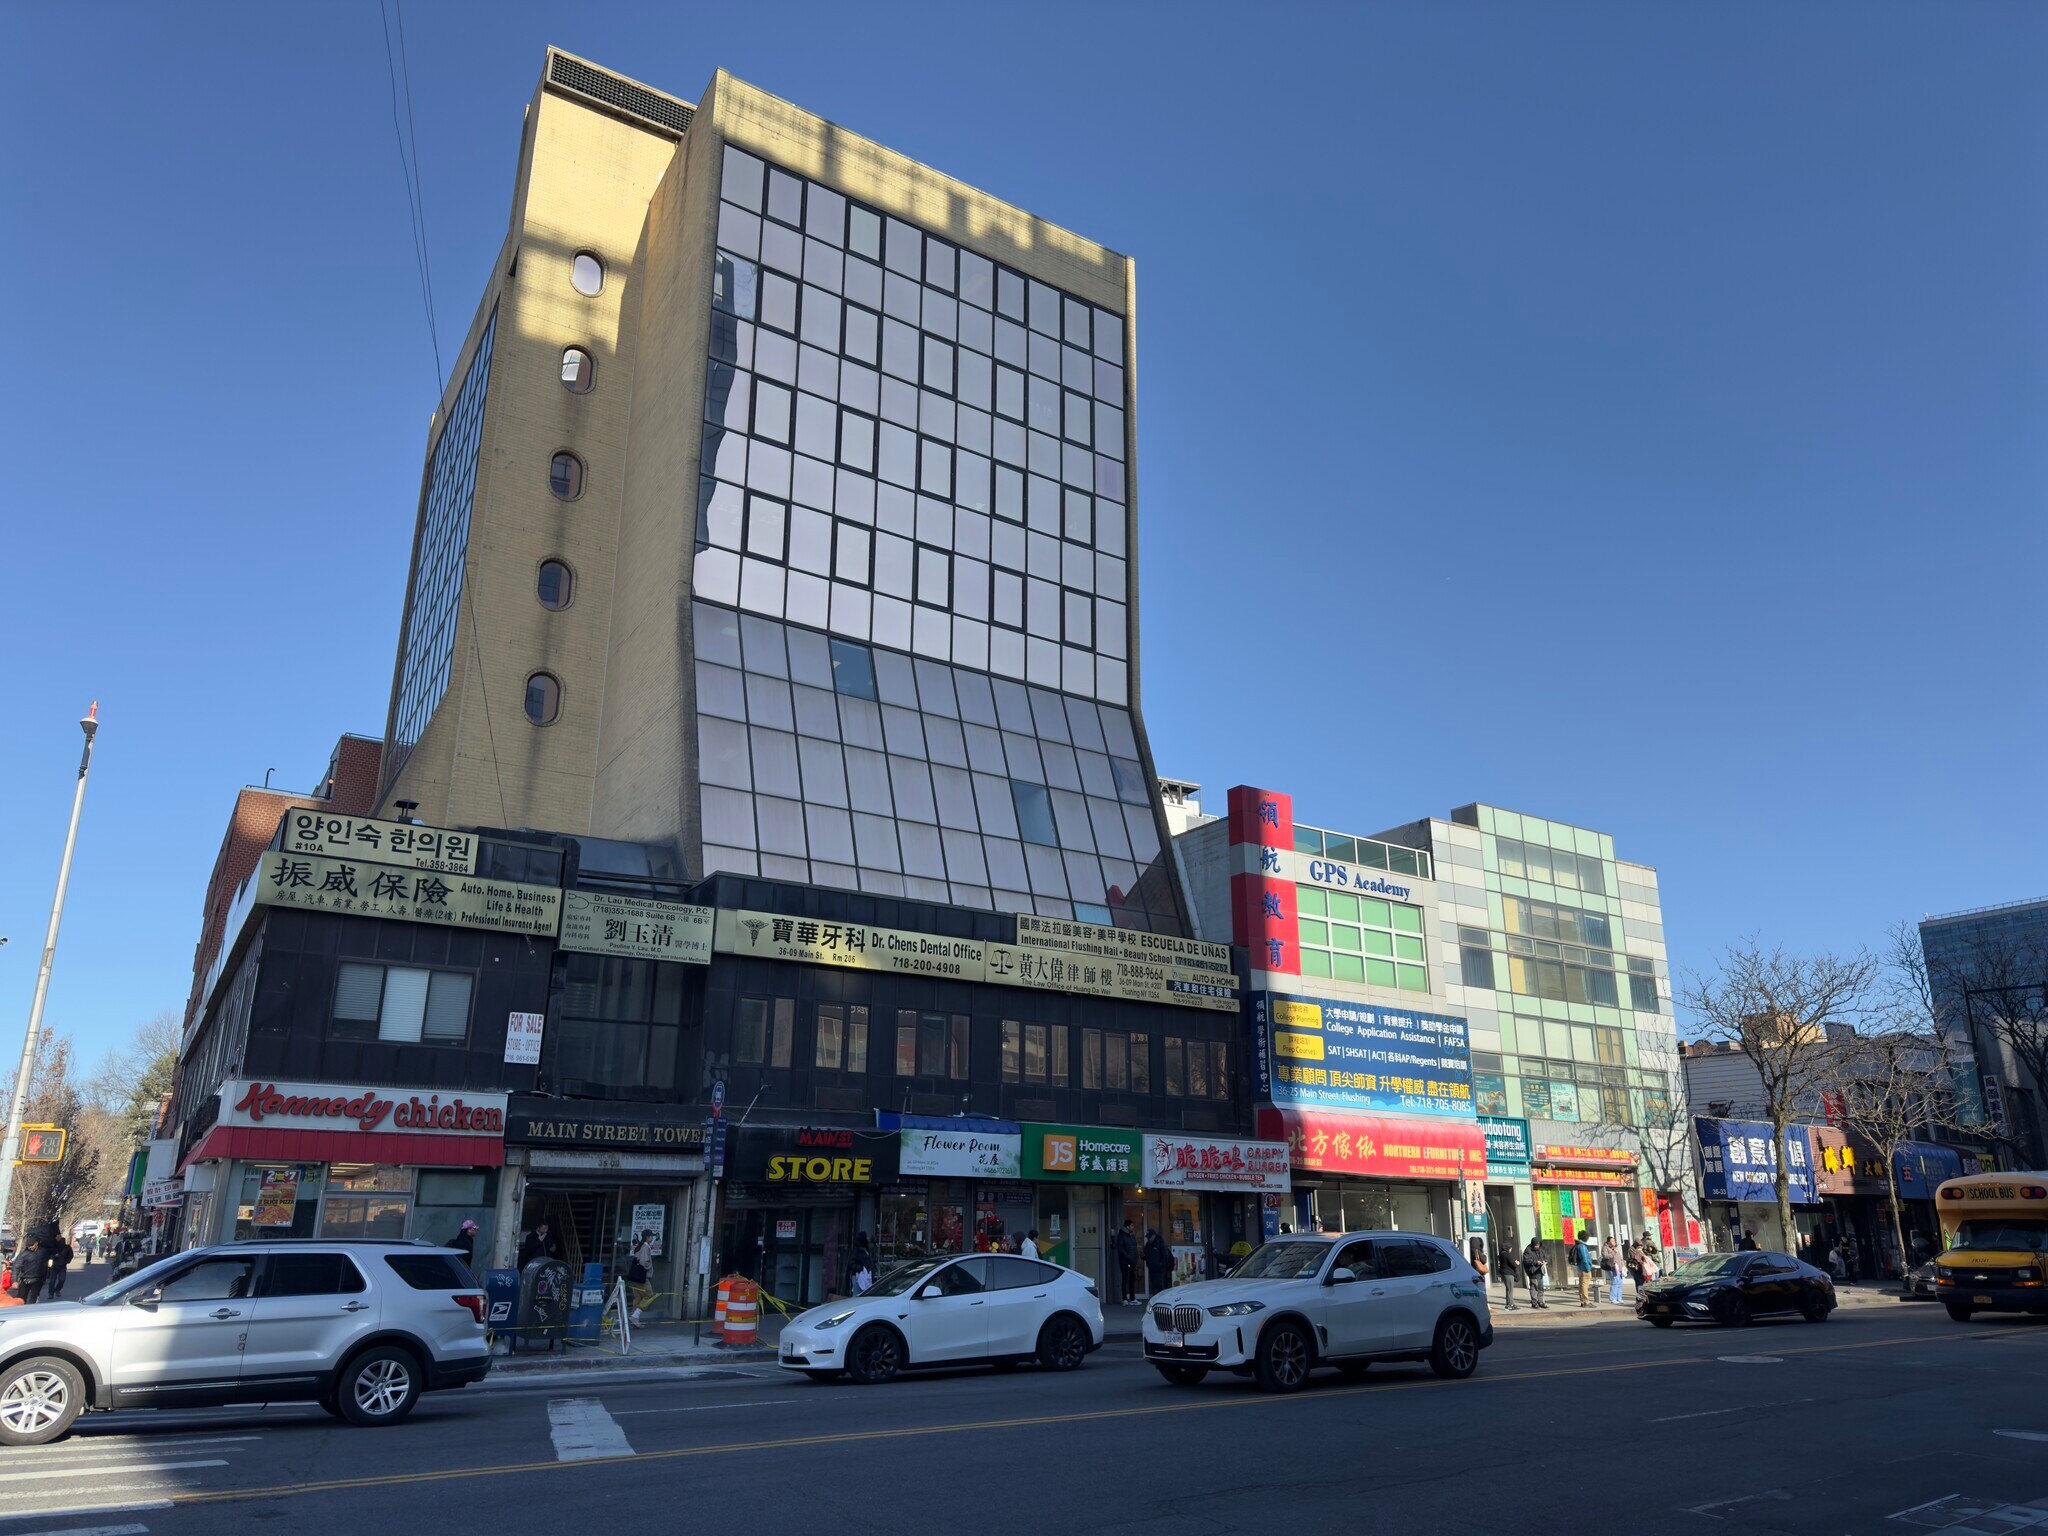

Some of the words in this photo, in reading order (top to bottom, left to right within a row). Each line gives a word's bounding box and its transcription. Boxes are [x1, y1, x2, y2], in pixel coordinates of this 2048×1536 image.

[295, 842, 324, 852] #10A
[297, 815, 382, 849] 양인숙
[390, 828, 470, 861] 한의원
[416, 858, 468, 873] Tel.358-3864
[270, 858, 454, 906] 振威保險
[1310, 860, 1348, 886] GPS
[1353, 873, 1411, 902] Academy
[487, 886, 515, 899] Home.
[517, 890, 556, 904] Business
[487, 901, 503, 912] Life
[505, 902, 512, 912] &
[515, 904, 543, 916] Health
[593, 905, 643, 918] (718)353-1688
[645, 911, 664, 920] Suite
[594, 895, 605, 903] Dr.
[608, 896, 622, 904] Lau
[624, 898, 654, 908] Medical
[696, 907, 710, 915] P.C.
[461, 911, 501, 926] Professional
[502, 918, 532, 930] Insurance
[533, 922, 552, 933] Agent
[604, 918, 674, 947] 劉玉清
[772, 918, 865, 952] 寶華牙科
[609, 942, 630, 950] Pauline
[779, 947, 797, 957] 36-09
[799, 948, 814, 958] Main
[833, 953, 842, 962] Rm
[844, 954, 856, 963] 206
[872, 933, 885, 948] Dr.
[888, 935, 918, 953] Chens
[921, 938, 950, 957] Dental
[954, 943, 982, 961] Office
[1021, 934, 1070, 950] International
[1071, 940, 1101, 956] Flushing
[1104, 945, 1118, 957] Nail
[1124, 949, 1147, 962] Beauty
[1149, 952, 1172, 965] School
[1141, 935, 1185, 953] ESCUELA
[1187, 942, 1199, 955] DE
[1201, 943, 1227, 960] UÑAS
[893, 957, 960, 974] 718-200-4908
[1019, 953, 1113, 987] 黃大偉律師樓
[1117, 963, 1163, 981] 718-888-9664
[1047, 981, 1064, 990] Office
[1066, 983, 1072, 991] of
[1073, 984, 1091, 994] Huang
[1133, 979, 1144, 987] Main
[1174, 981, 1231, 998] 汽車和住宅保險
[1192, 974, 1209, 984] AUTO
[1210, 976, 1215, 984] &
[1217, 978, 1235, 987] HOME
[1122, 988, 1140, 998] Flushing
[1140, 990, 1148, 998] NY
[510, 1014, 523, 1033] FOR
[526, 1015, 542, 1034] SALE
[1326, 1021, 1354, 1036] College
[1357, 1025, 1398, 1040] Application
[1400, 1030, 1435, 1044] Assistance
[1444, 1035, 1466, 1048] FAFSA
[1328, 1045, 1341, 1056] SAT
[1346, 1048, 1367, 1059] SHSAT
[1372, 1050, 1384, 1061] ACT
[1277, 1065, 1327, 1086] 專業顧問
[1329, 1069, 1377, 1091] 頂尖師資
[1379, 1075, 1425, 1096] 升學權威
[1278, 1086, 1298, 1097] 36-25
[1299, 1087, 1317, 1098] Main
[1341, 1091, 1371, 1106] Flushing
[235, 1082, 394, 1131] Kennedy
[394, 1094, 503, 1131] chicken
[527, 1121, 582, 1139] MAIN
[582, 1124, 648, 1142] STREET
[800, 1129, 837, 1146] MAIN
[838, 1131, 852, 1144] ST
[924, 1135, 966, 1152] Flower
[968, 1138, 1000, 1153] Room
[1050, 1141, 1073, 1166] JS
[1079, 1140, 1131, 1153] Homecare
[1246, 1146, 1285, 1159] CRISPY
[1383, 1144, 1421, 1159] NORTHERN
[1469, 1150, 1484, 1162] INC.
[768, 1156, 872, 1182] STORE
[979, 1154, 999, 1166] 花屋
[1247, 1160, 1288, 1174] BURGER
[1732, 1171, 1744, 1183] NEW
[1712, 1188, 1727, 1196] 36-33
[1968, 1188, 1999, 1200] SCHOOL
[2000, 1188, 2015, 1199] BUS
